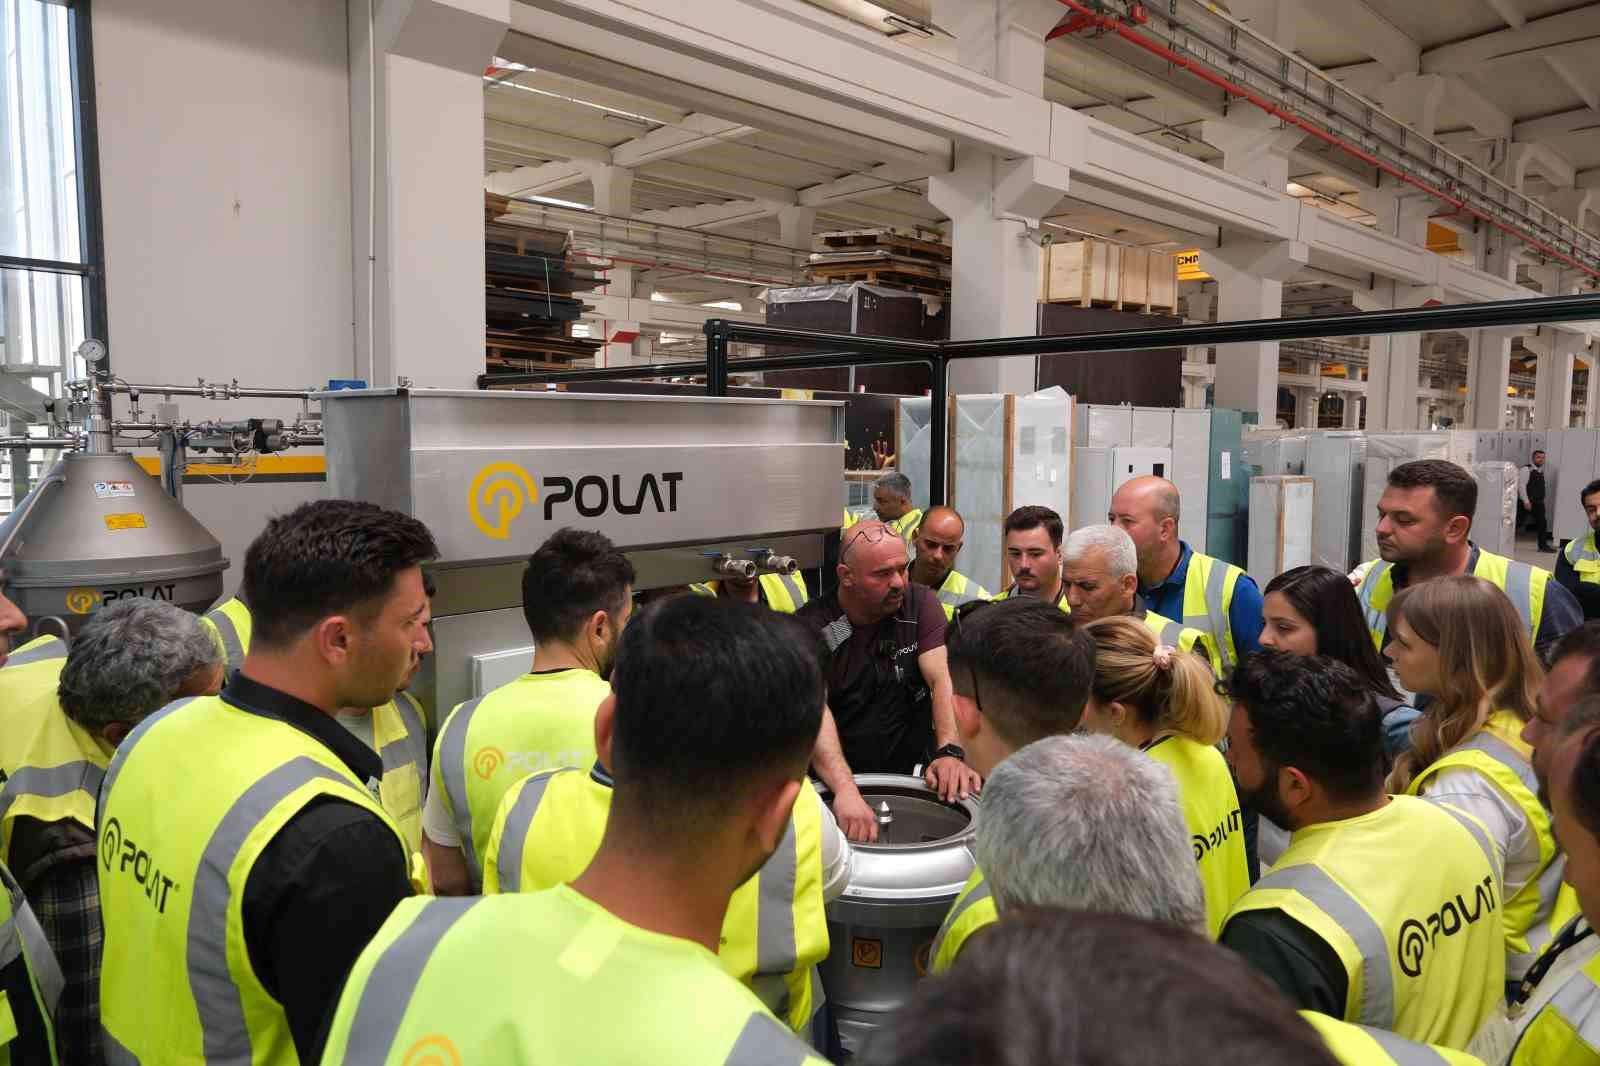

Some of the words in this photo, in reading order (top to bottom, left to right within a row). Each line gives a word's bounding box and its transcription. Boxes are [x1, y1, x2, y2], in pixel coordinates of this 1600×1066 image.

[543, 472, 683, 521] POLAT
[120, 838, 174, 914] POLAT
[1426, 875, 1495, 951] POLAT
